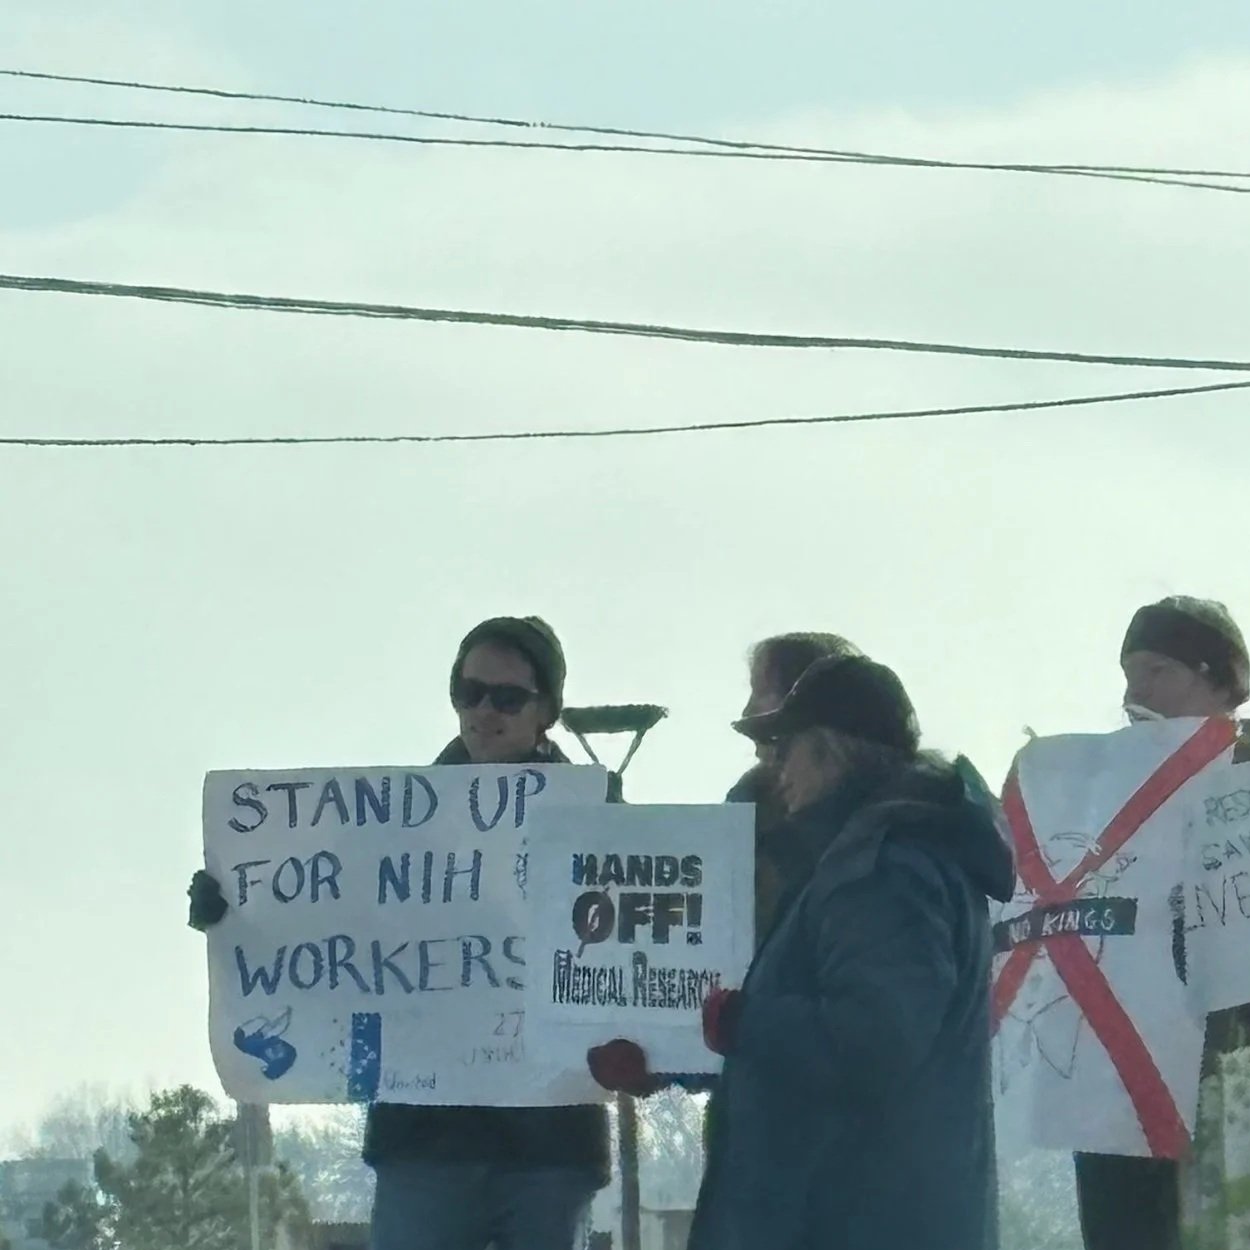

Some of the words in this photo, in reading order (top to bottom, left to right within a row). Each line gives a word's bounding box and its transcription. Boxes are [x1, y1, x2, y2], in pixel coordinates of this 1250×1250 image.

[227, 773, 440, 833] STAND
[468, 768, 547, 832] UP
[231, 850, 343, 906] FOR
[377, 848, 482, 905] NIH
[572, 853, 703, 887] HANDS
[1041, 908, 1115, 936] KINGS
[235, 934, 527, 996] WORKERS
[553, 949, 627, 1007] MEDICAL
